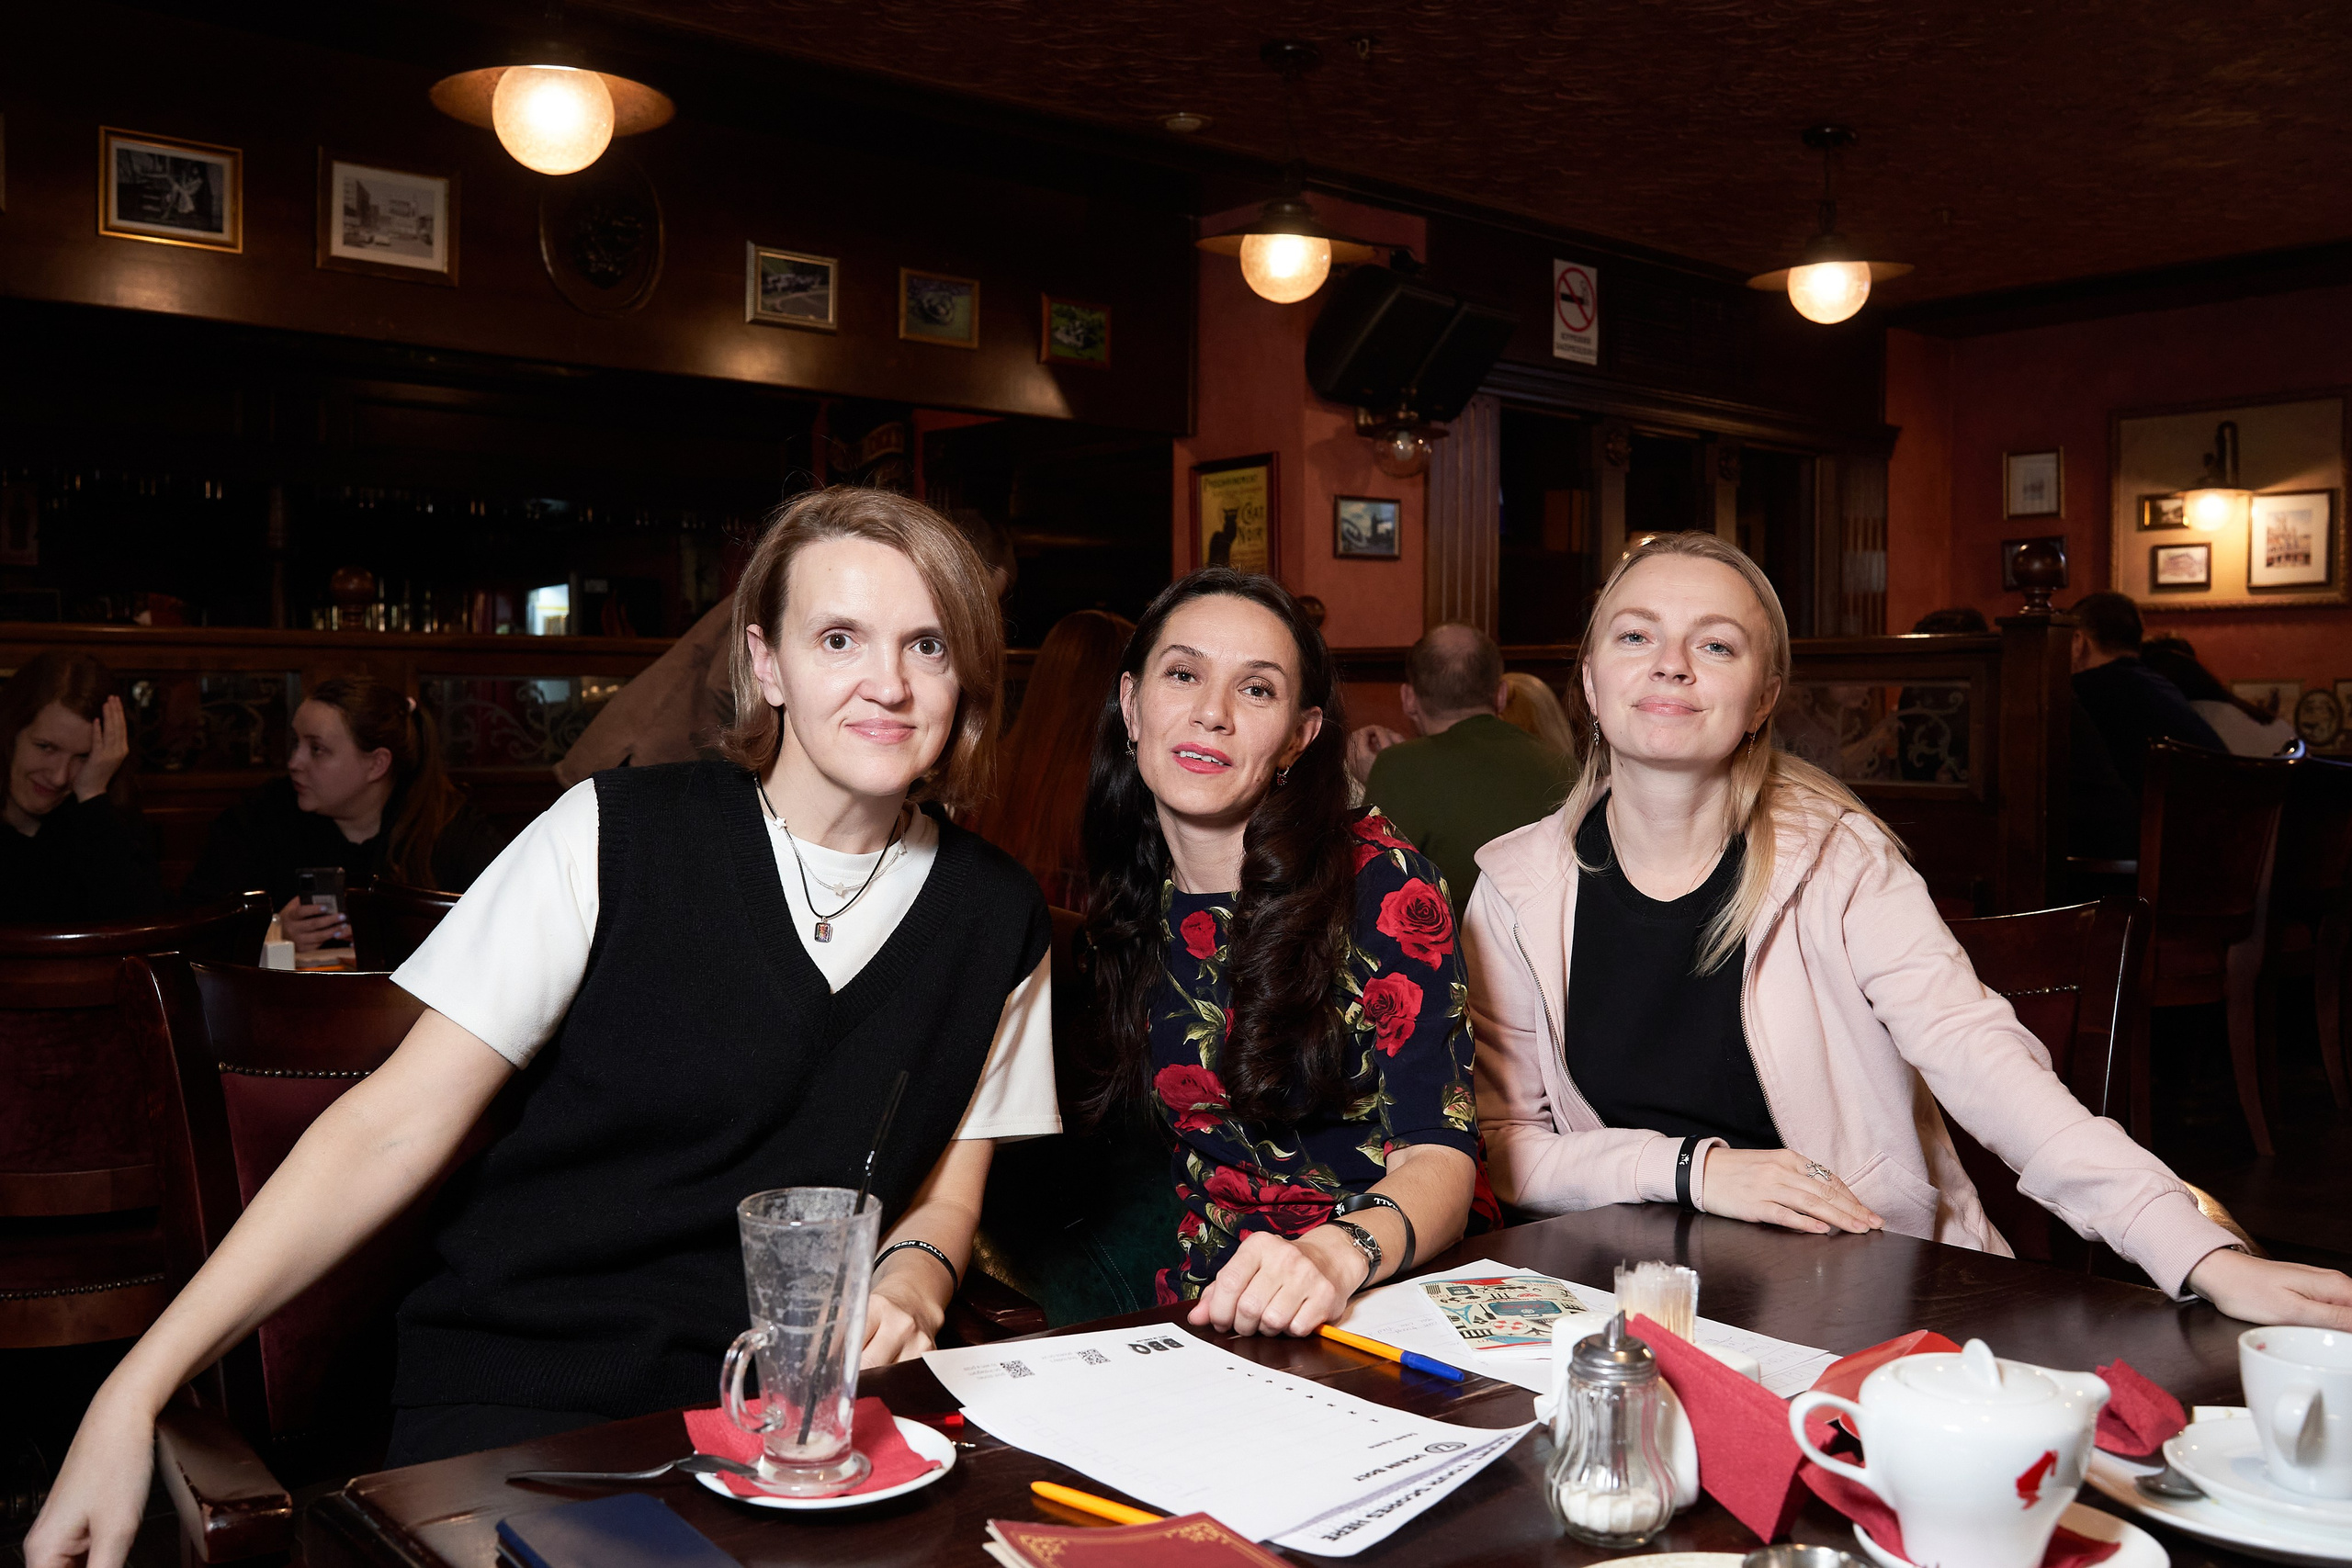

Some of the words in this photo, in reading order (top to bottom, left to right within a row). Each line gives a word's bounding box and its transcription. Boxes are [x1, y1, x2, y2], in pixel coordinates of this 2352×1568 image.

[918, 1242, 944, 1259] HALL
[1126, 1337, 1184, 1355] BBQ
[1385, 1454, 1427, 1470] USAIN
[1353, 1467, 1386, 1482] BOLT
[1366, 1486, 1431, 1518] SCORES
[1320, 1518, 1372, 1541] HERE
